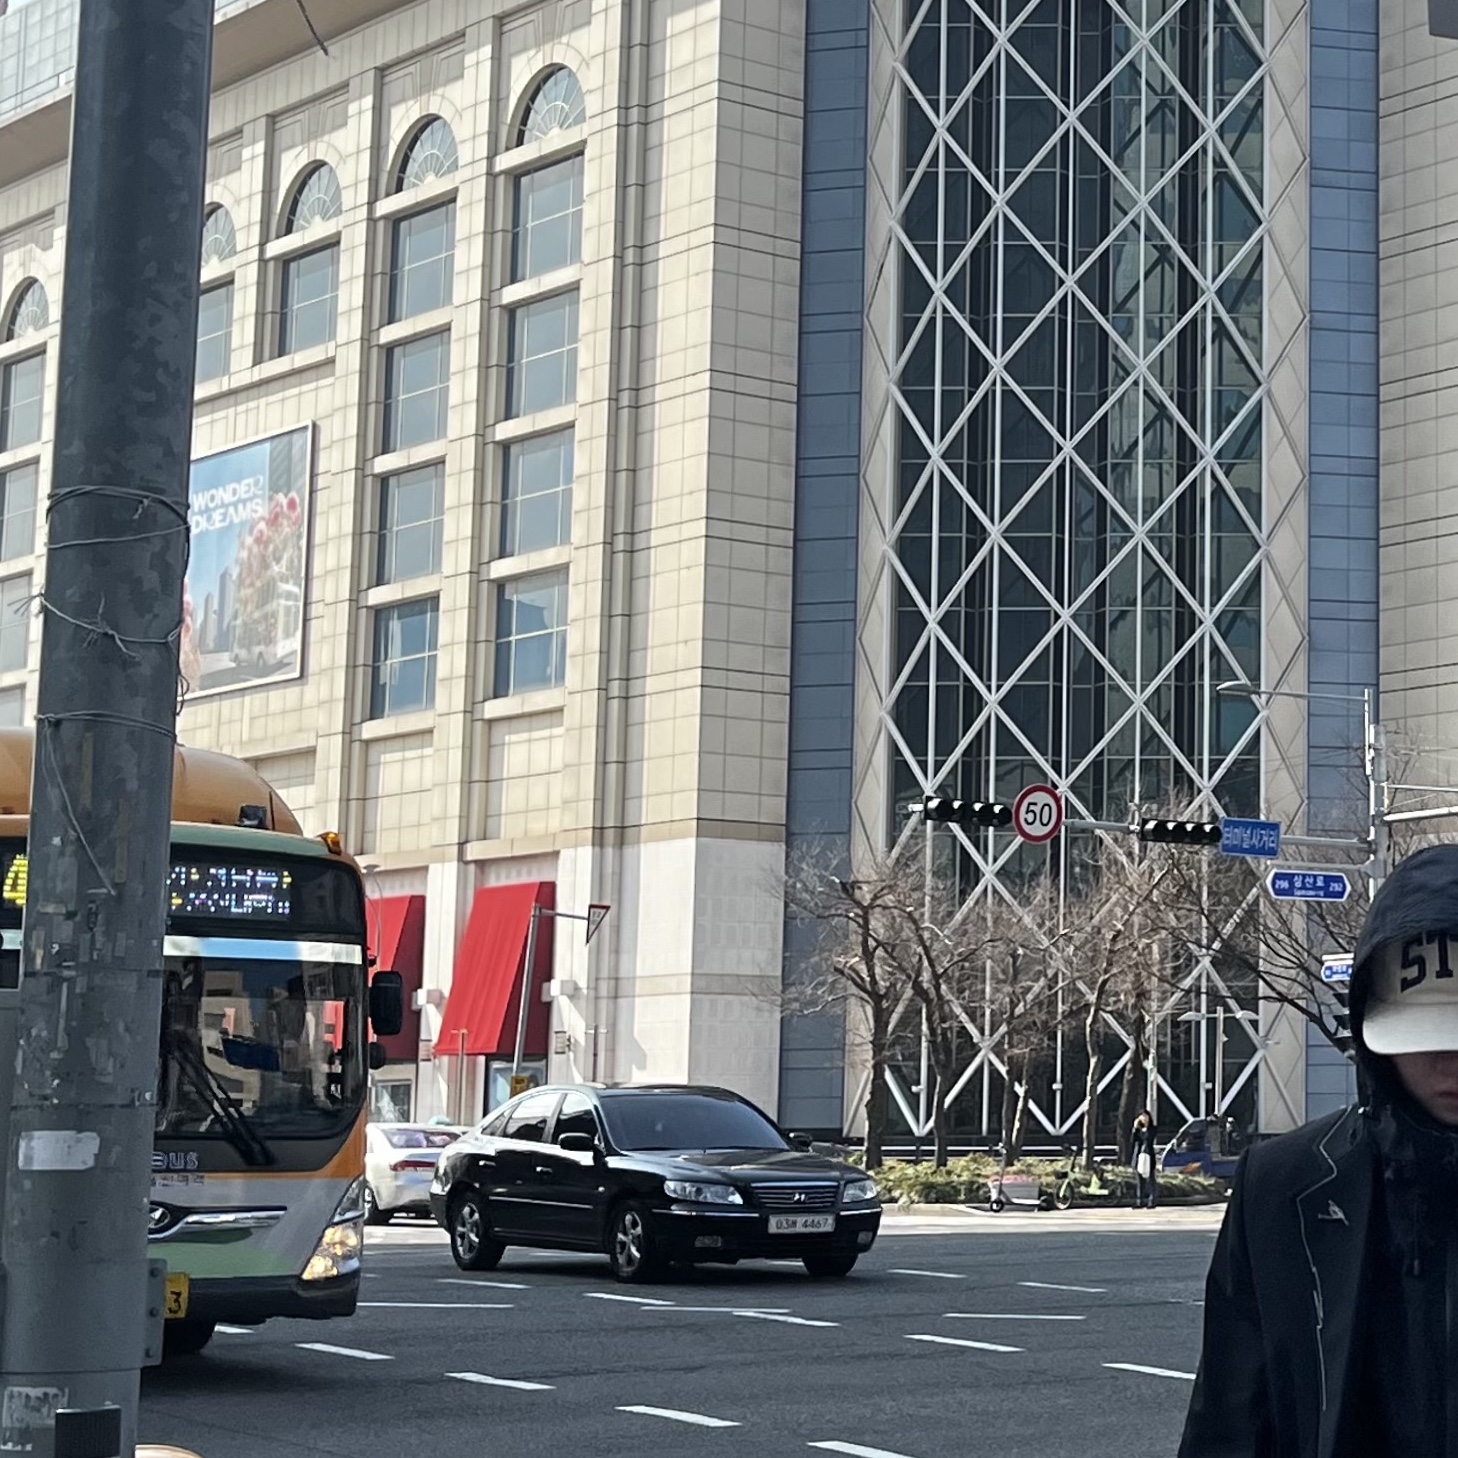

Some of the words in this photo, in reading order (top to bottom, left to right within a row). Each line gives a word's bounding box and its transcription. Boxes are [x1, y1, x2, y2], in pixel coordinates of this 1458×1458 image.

[192, 475, 264, 513] WONDER
[191, 498, 262, 535] DREAMS
[1024, 802, 1052, 827] 50
[1223, 825, 1278, 852] 터미널사거리
